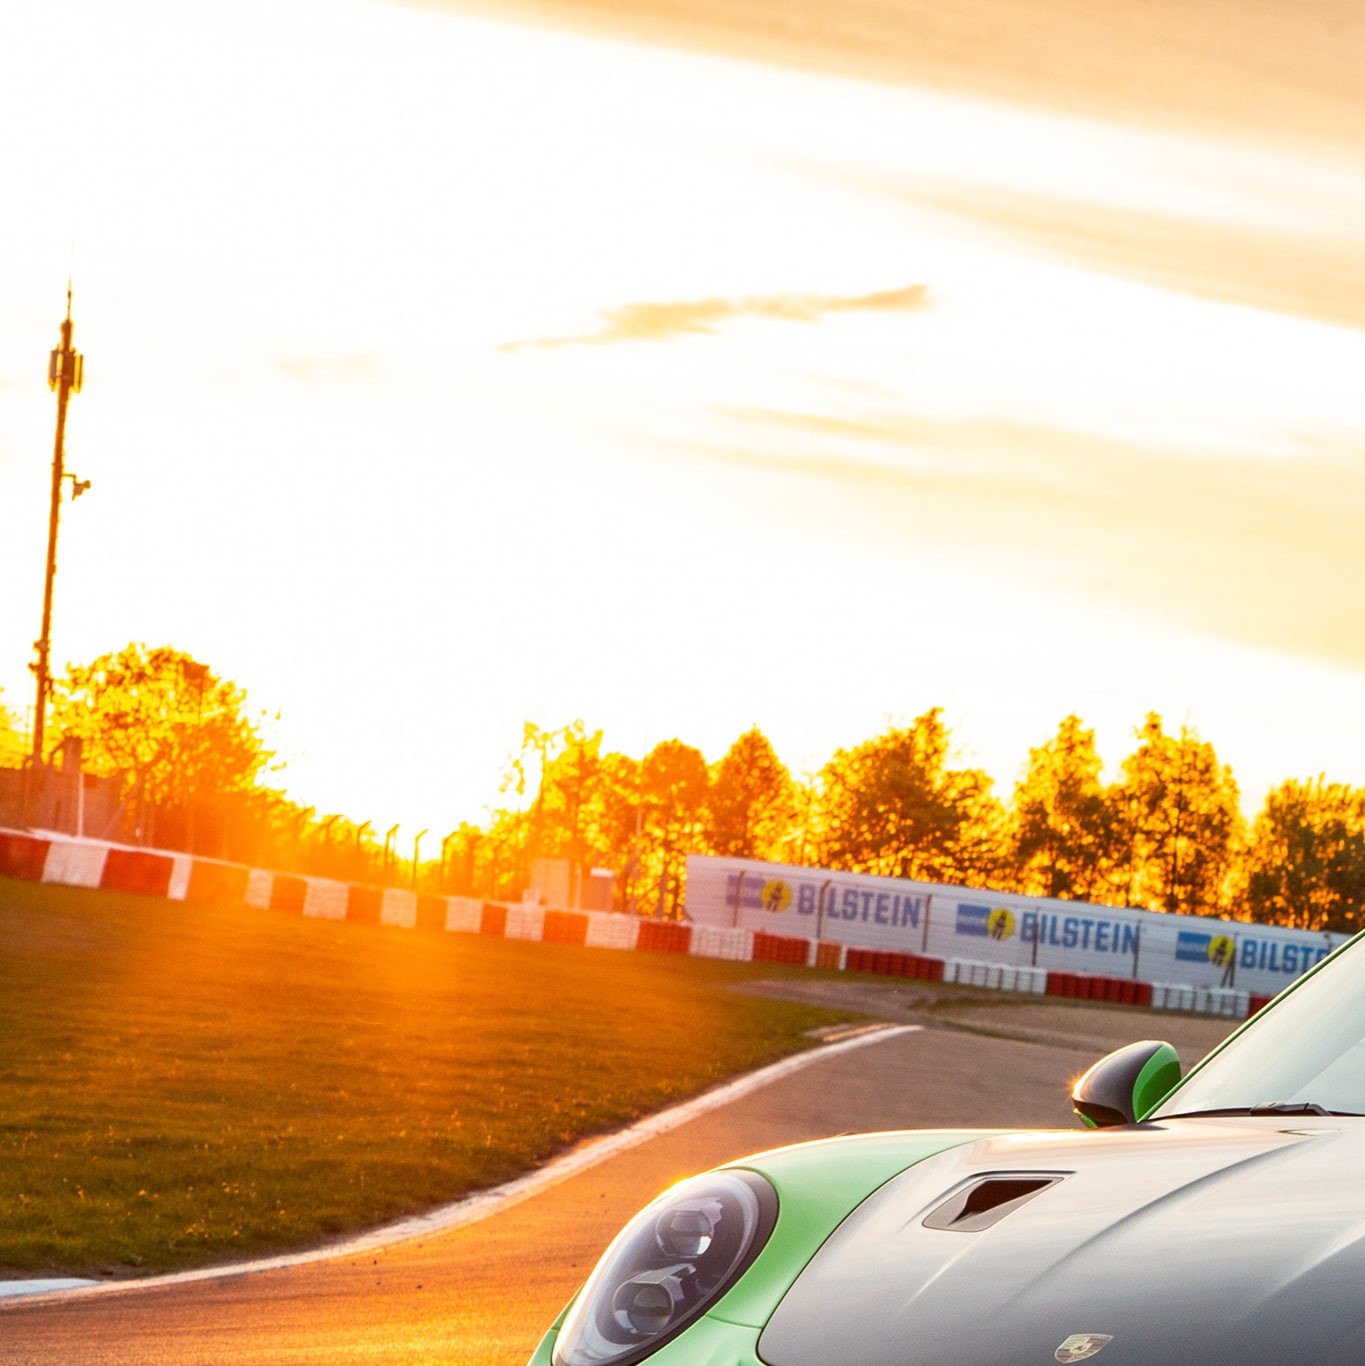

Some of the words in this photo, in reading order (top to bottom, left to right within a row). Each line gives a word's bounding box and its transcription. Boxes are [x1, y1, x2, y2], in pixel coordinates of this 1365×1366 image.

[797, 883, 921, 930] BLSTEIN
[1019, 911, 1140, 956] BILSTEIN
[1240, 939, 1331, 975] BILST
